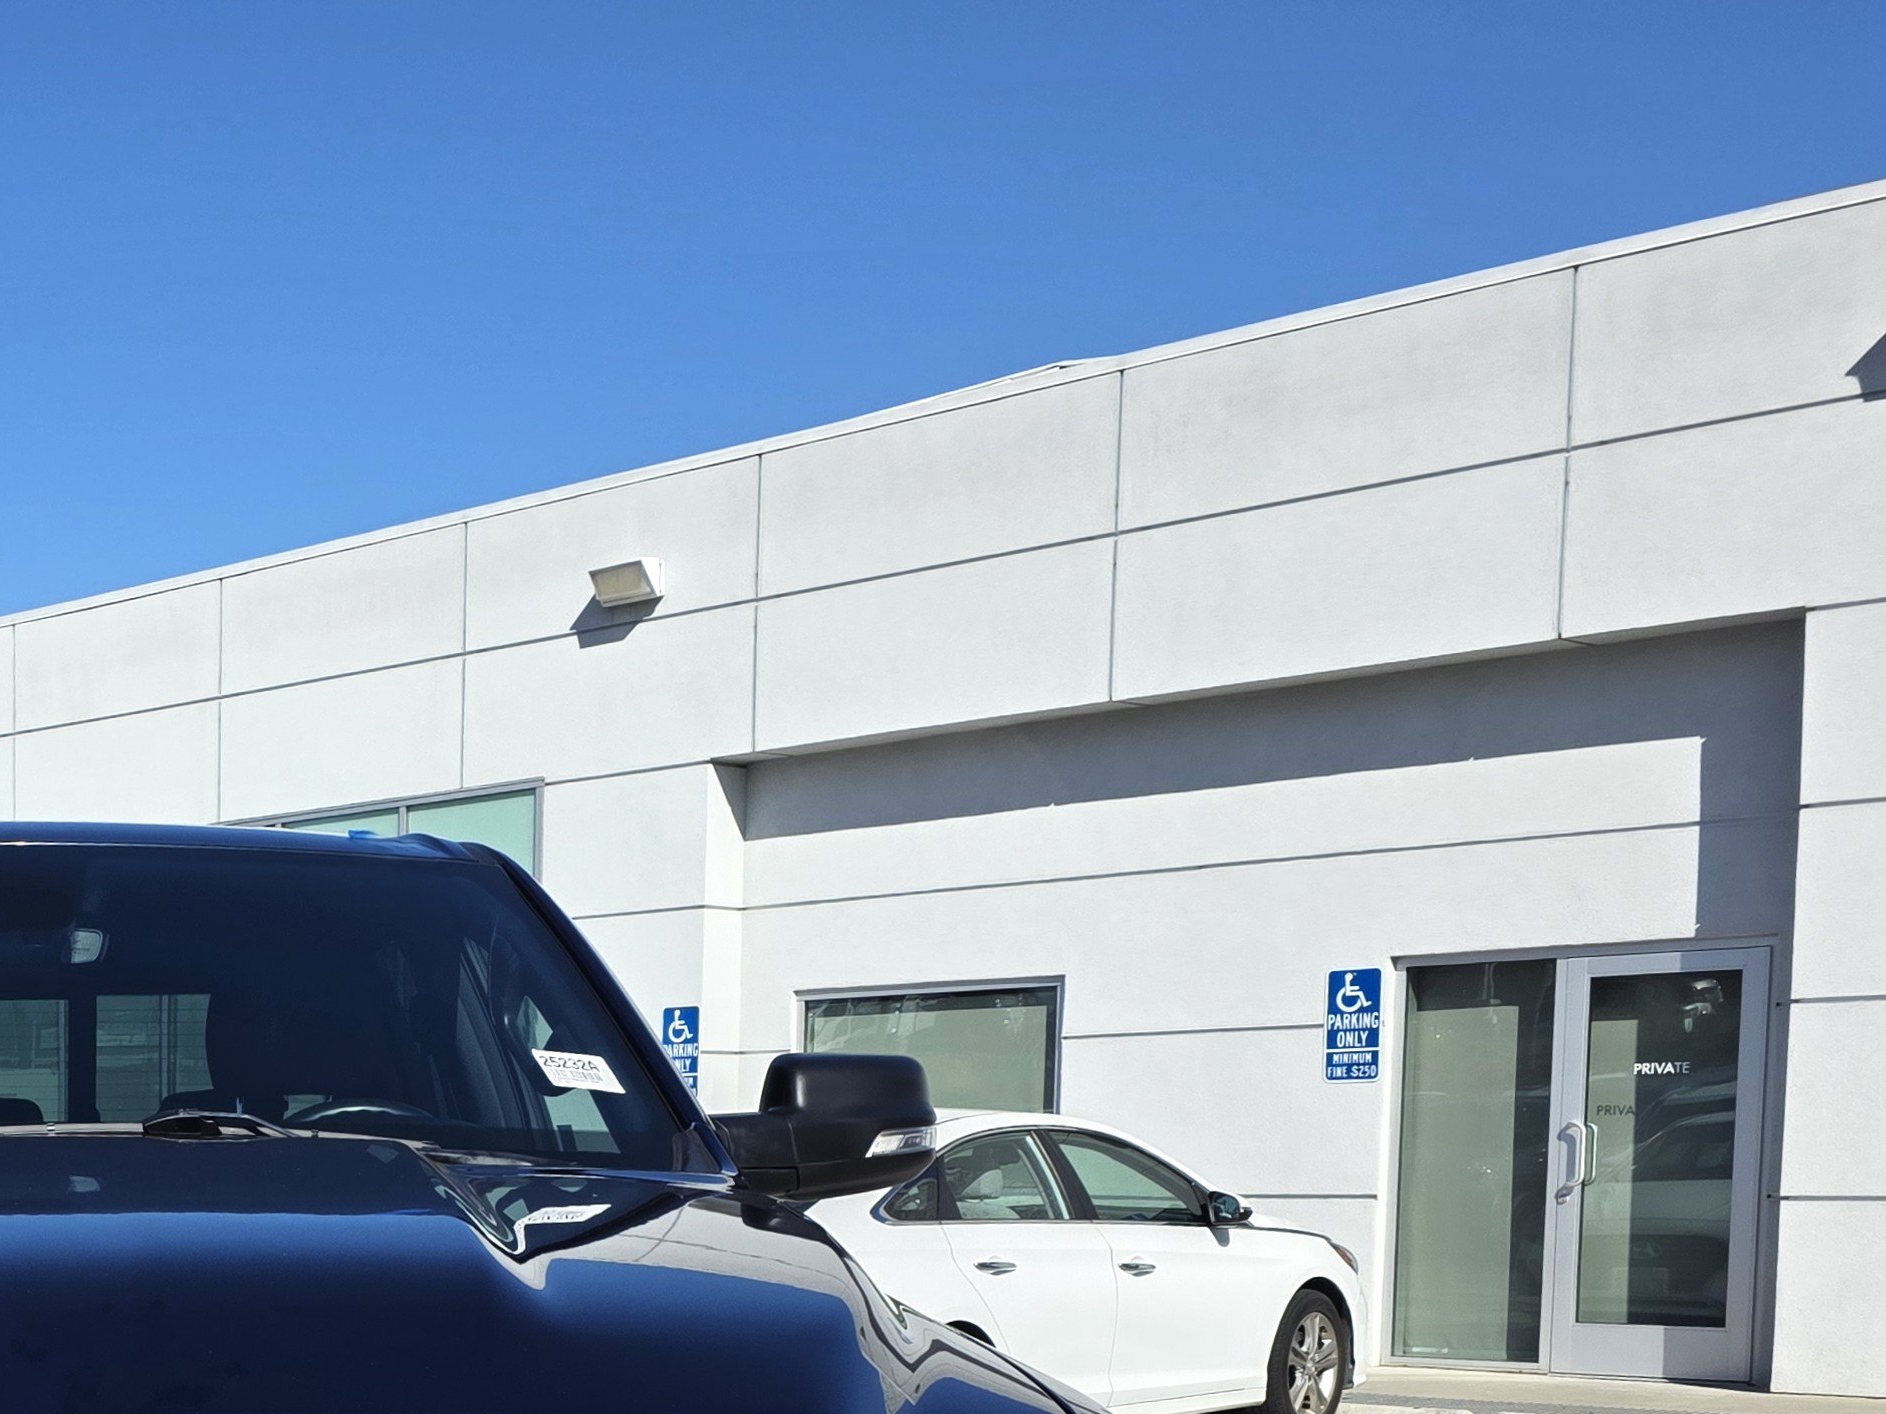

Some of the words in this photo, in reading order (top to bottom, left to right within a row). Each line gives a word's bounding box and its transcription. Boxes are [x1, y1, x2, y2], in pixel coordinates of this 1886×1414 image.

[1327, 1011, 1379, 1030] PARKING
[1336, 1030, 1369, 1048] ONLY
[539, 1055, 601, 1072] 25232A
[675, 1058, 692, 1072] NLY
[1332, 1052, 1372, 1064] MINIMUM
[1327, 1066, 1347, 1078] FINE
[1350, 1065, 1377, 1077] $250
[1633, 1061, 1691, 1075] PRIVATE
